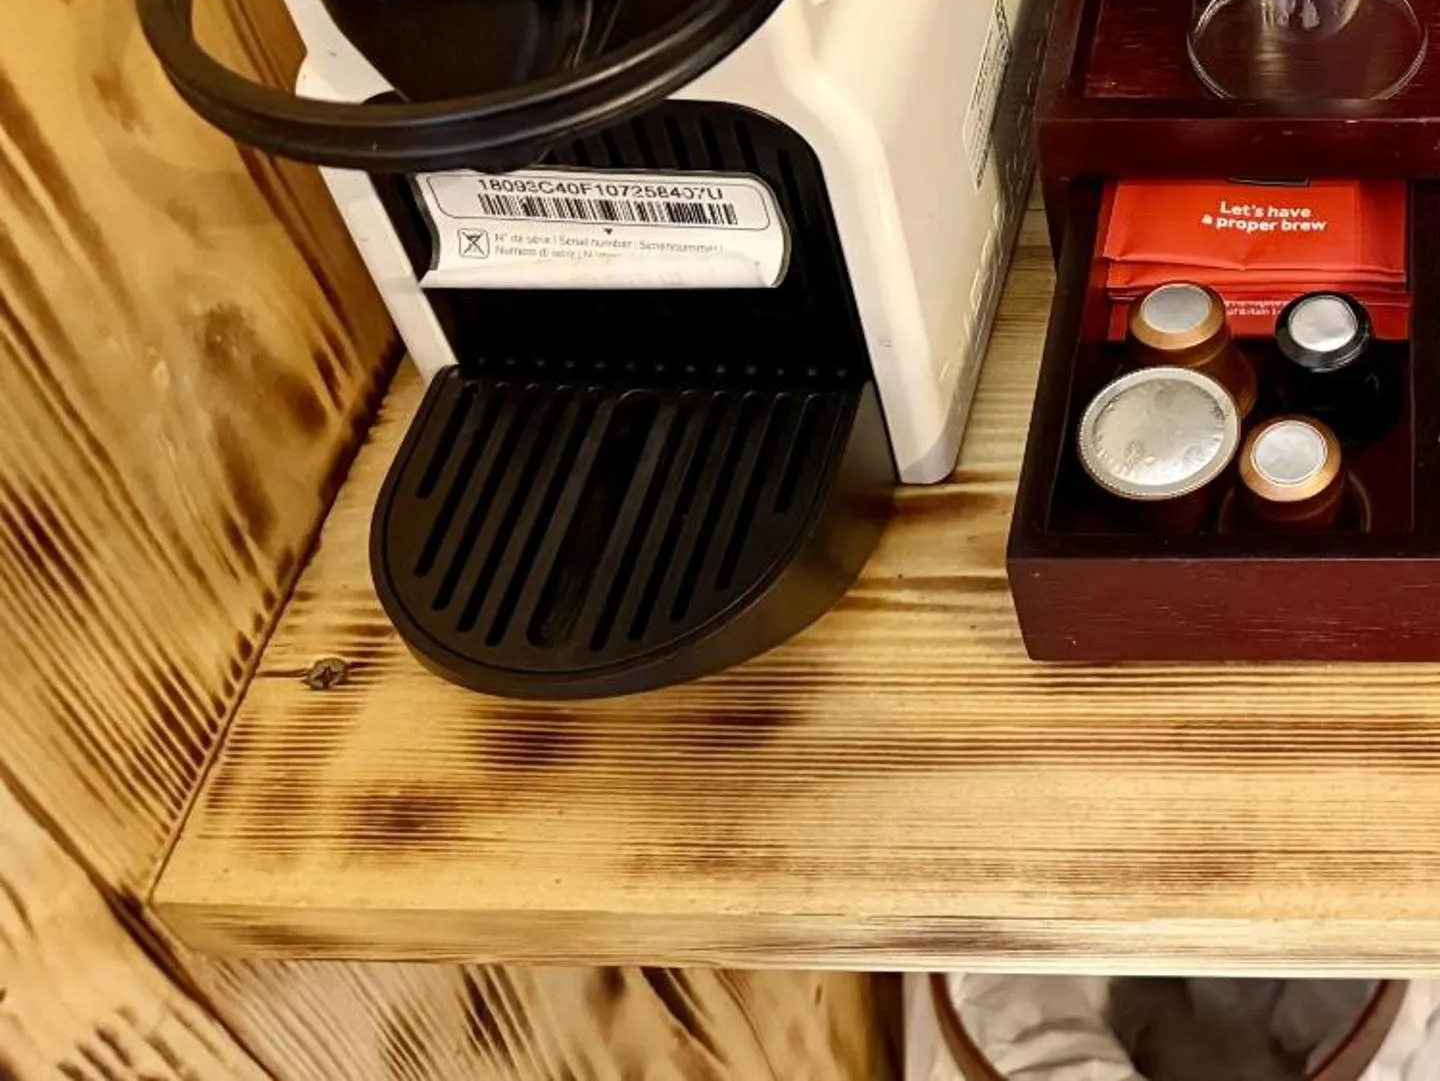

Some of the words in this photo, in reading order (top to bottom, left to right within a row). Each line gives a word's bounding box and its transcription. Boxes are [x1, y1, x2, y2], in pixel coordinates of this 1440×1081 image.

[1220, 201, 1264, 217] Let's
[1268, 206, 1312, 218] have
[1202, 214, 1213, 225] a
[1216, 217, 1278, 233] proper
[1281, 219, 1327, 232] brew
